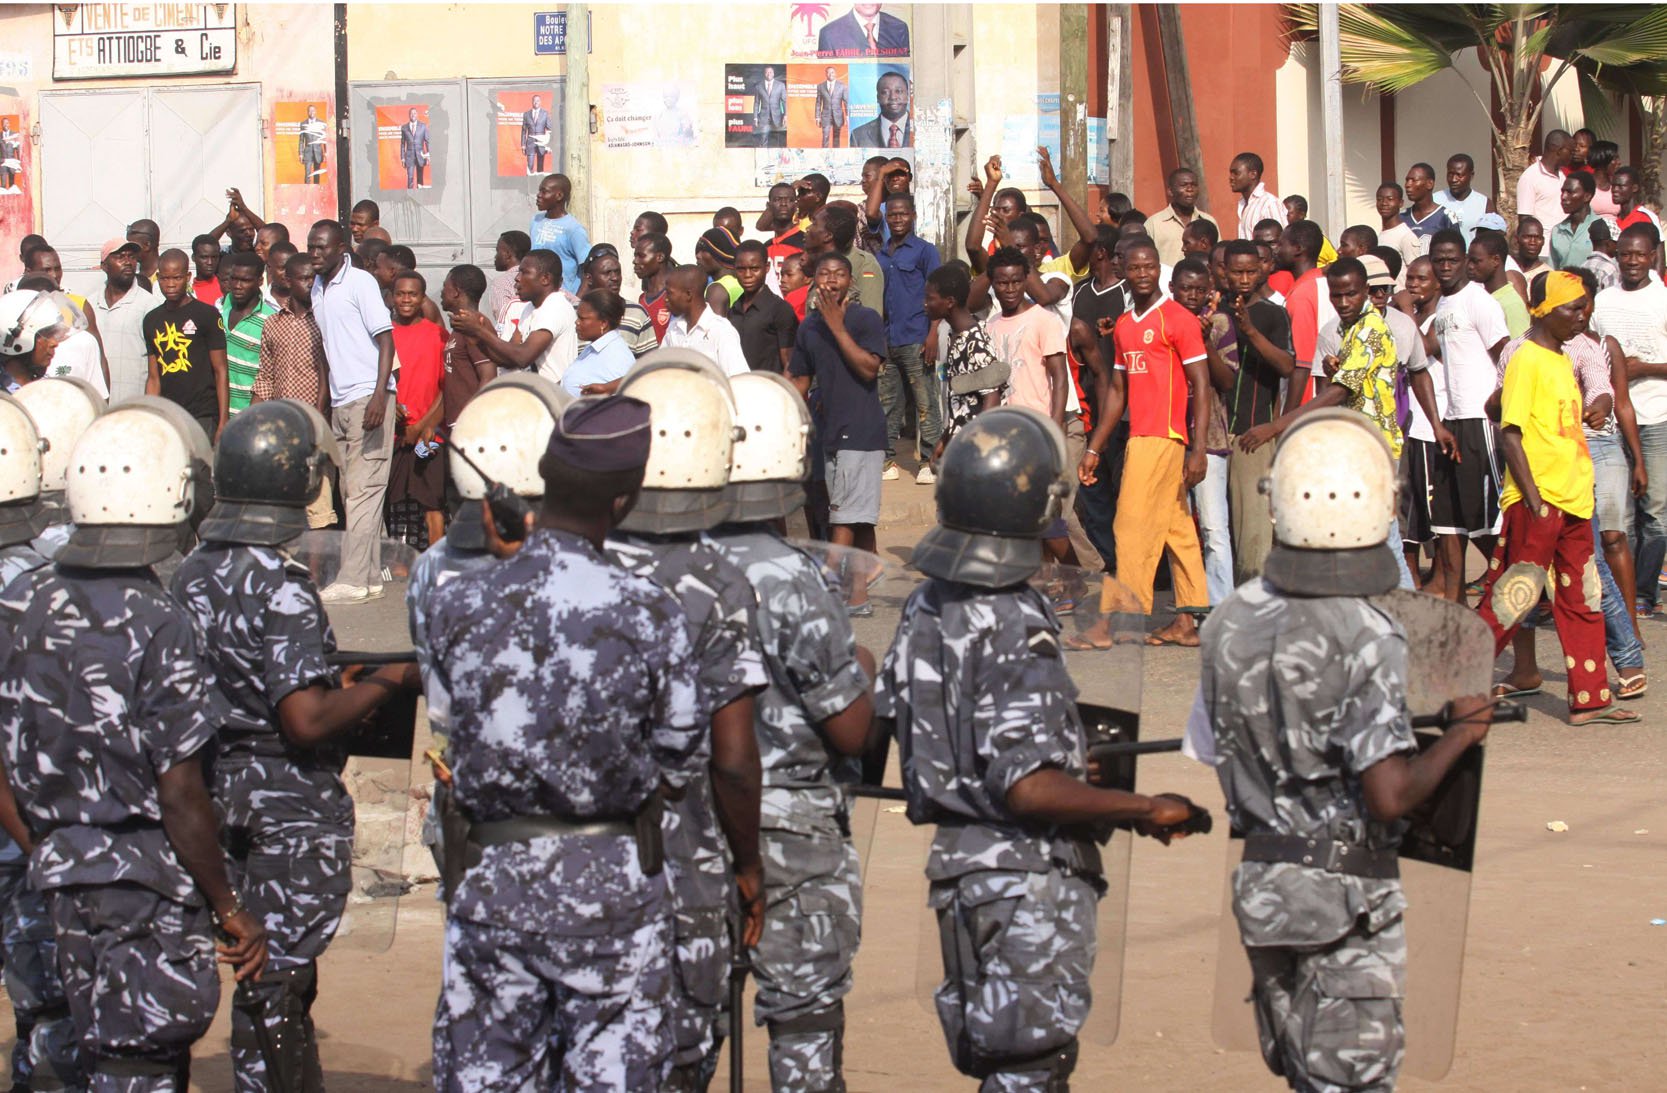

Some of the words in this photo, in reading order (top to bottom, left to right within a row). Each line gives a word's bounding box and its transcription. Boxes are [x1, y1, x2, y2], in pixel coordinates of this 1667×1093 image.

[86, 3, 128, 30] VENTE
[133, 7, 150, 21] DE
[154, 3, 200, 28] CIMENT
[540, 25, 563, 35] NOTRE
[539, 36, 553, 45] DES
[98, 34, 161, 64] ATTIOGBE
[174, 38, 188, 57] &
[200, 32, 221, 60] Cie
[728, 118, 744, 127] plus
